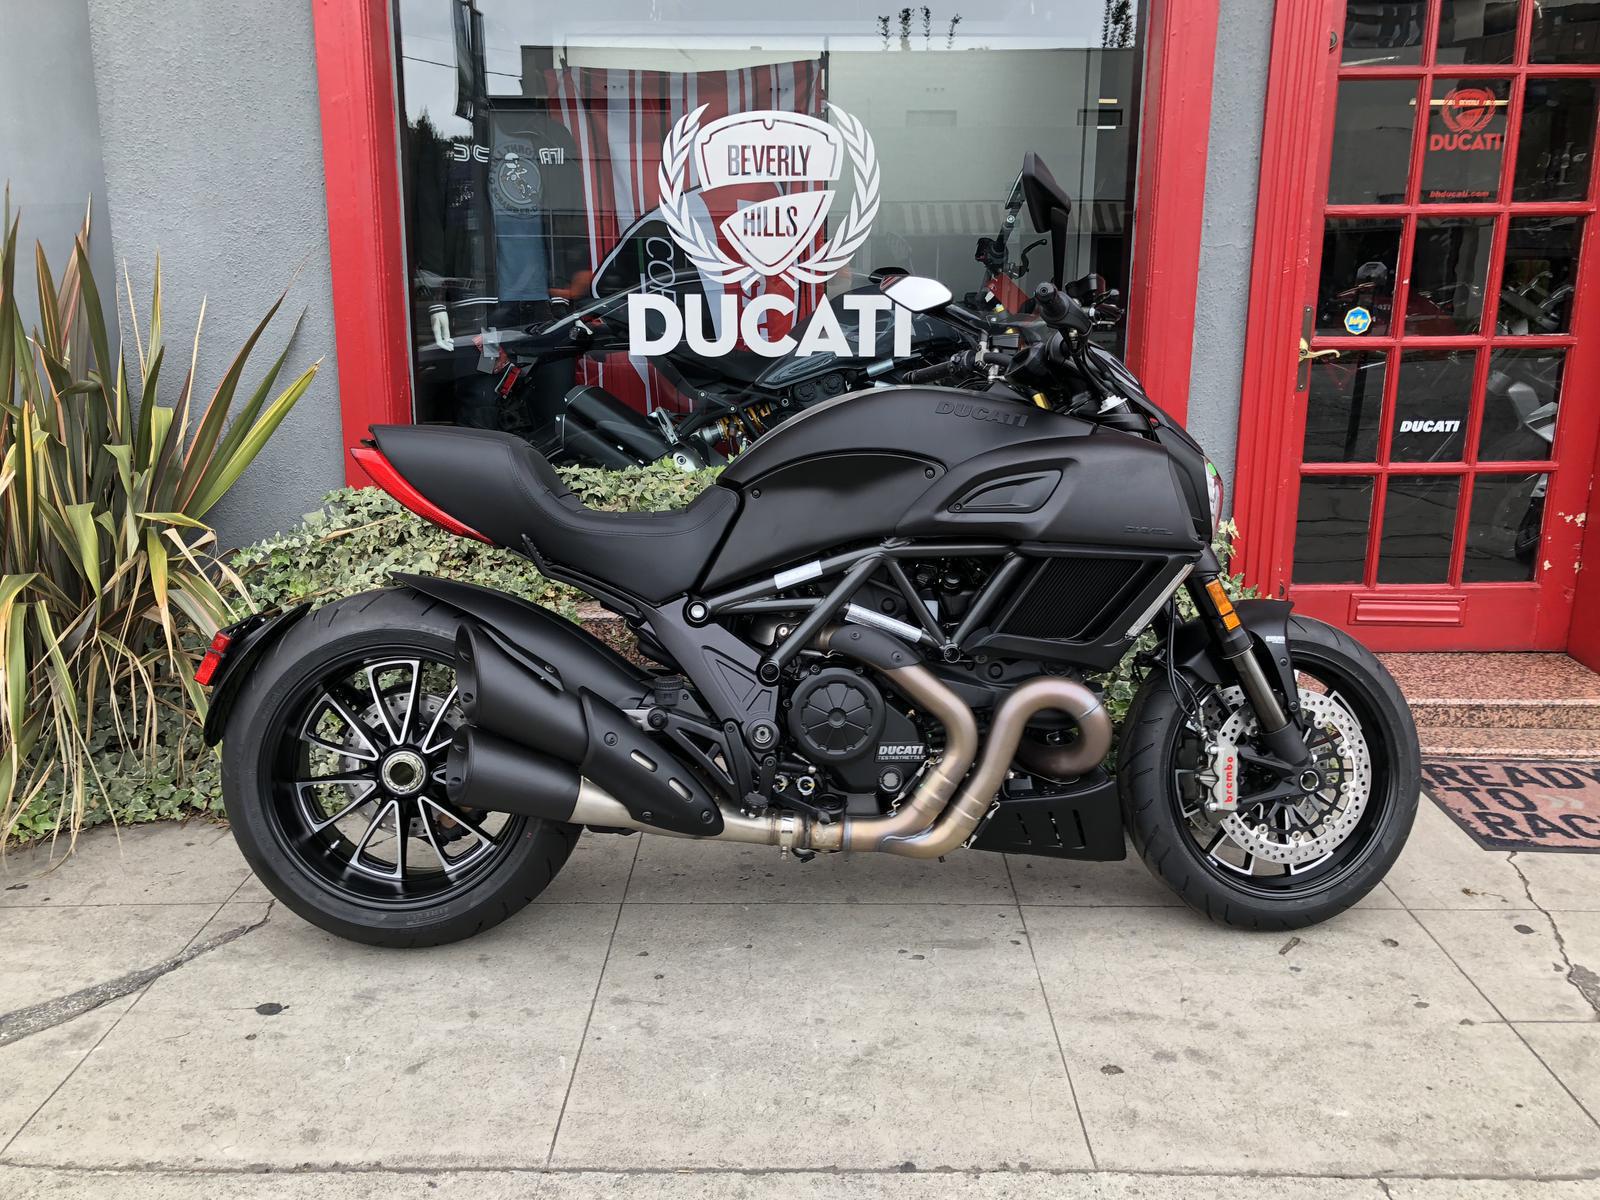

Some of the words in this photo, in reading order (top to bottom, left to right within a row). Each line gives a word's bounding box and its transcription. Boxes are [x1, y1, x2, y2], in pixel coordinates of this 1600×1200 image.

[1429, 133, 1502, 152] DUCATI
[727, 144, 812, 177] BEVERLY
[743, 205, 798, 238] HILLS
[627, 293, 912, 358] DUCATI
[935, 401, 1029, 427] DUCATI
[1399, 420, 1461, 433] DUCATI
[878, 745, 924, 755] DUCATI
[1223, 756, 1234, 803] brembo
[1444, 786, 1538, 812] TO
[1472, 811, 1600, 840] RAC
